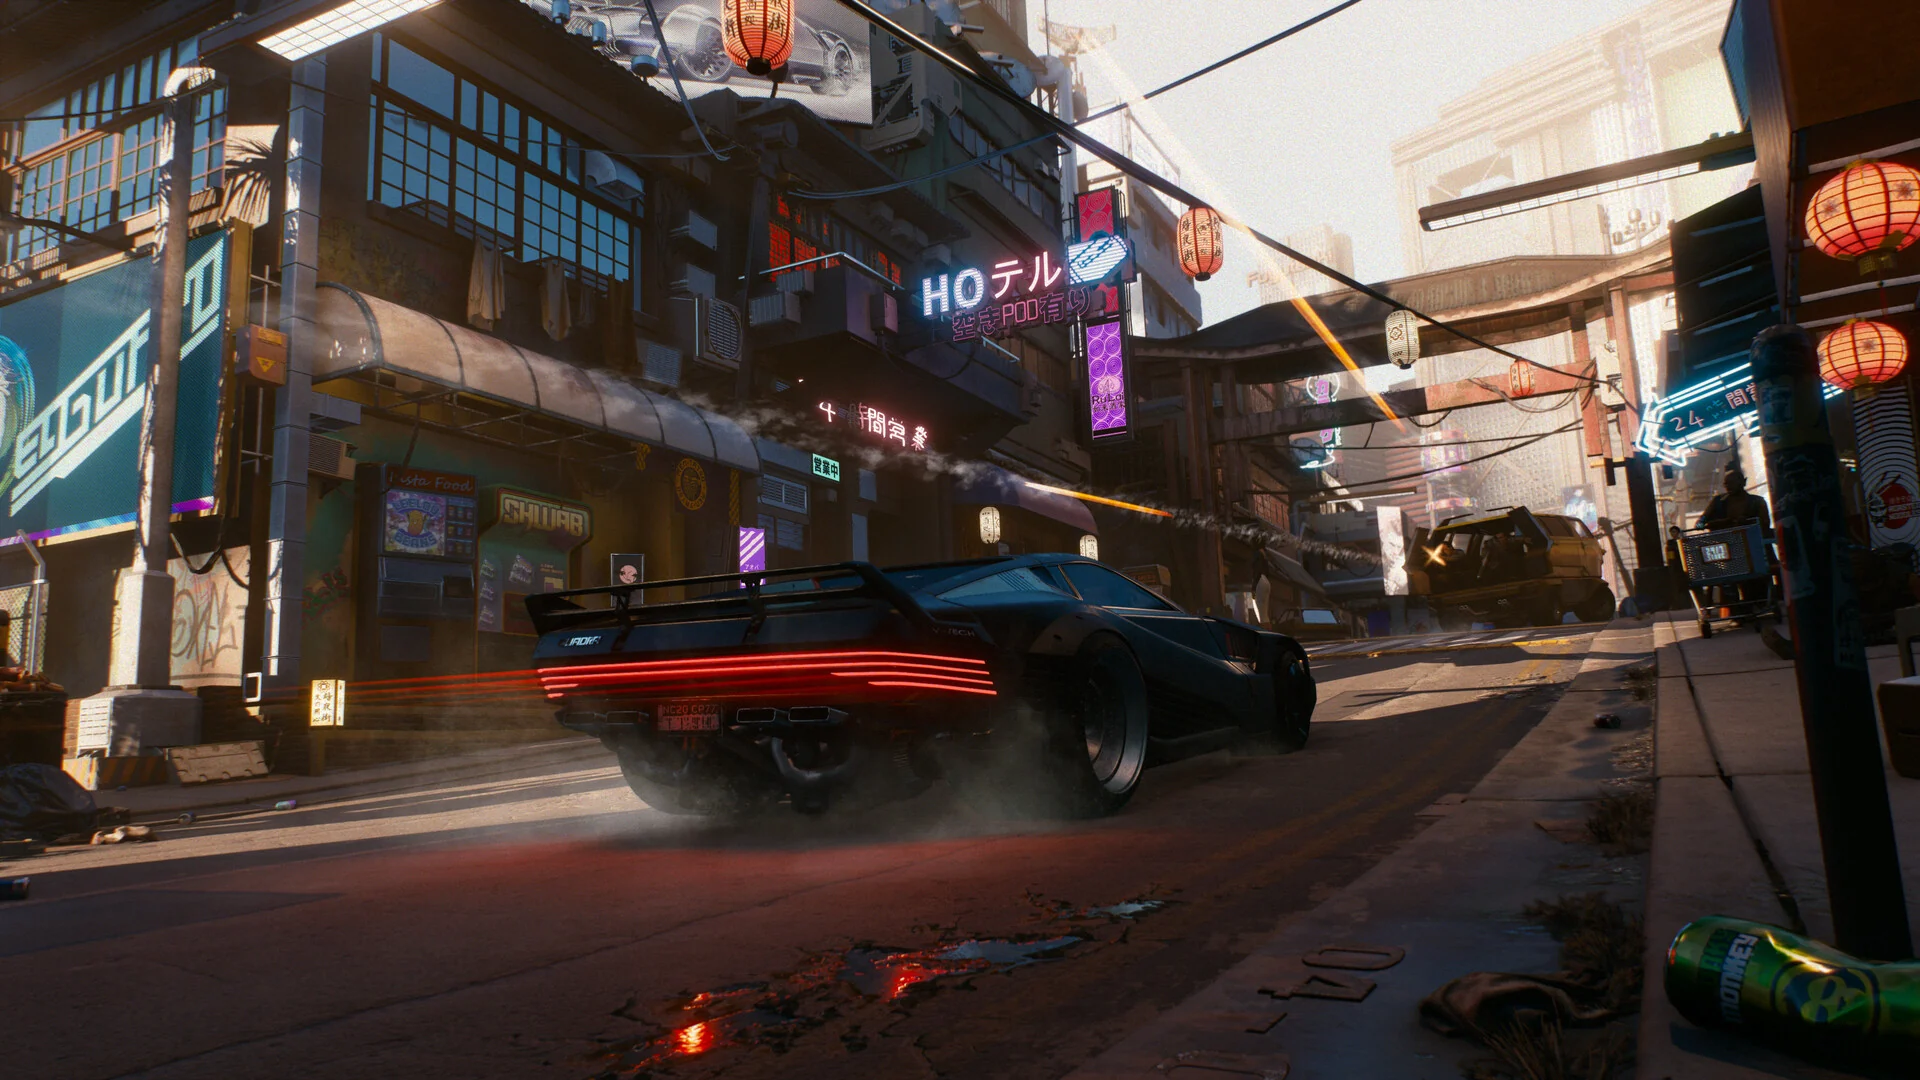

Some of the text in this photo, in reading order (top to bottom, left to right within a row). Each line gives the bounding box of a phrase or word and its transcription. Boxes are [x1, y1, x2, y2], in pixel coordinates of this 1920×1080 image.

[922, 250, 1062, 316] HOテル
[952, 286, 1091, 341] 空きPOD有り
[434, 476, 473, 493] Food
[814, 457, 838, 478] 営業中
[1723, 932, 1761, 1024] MONKEY
